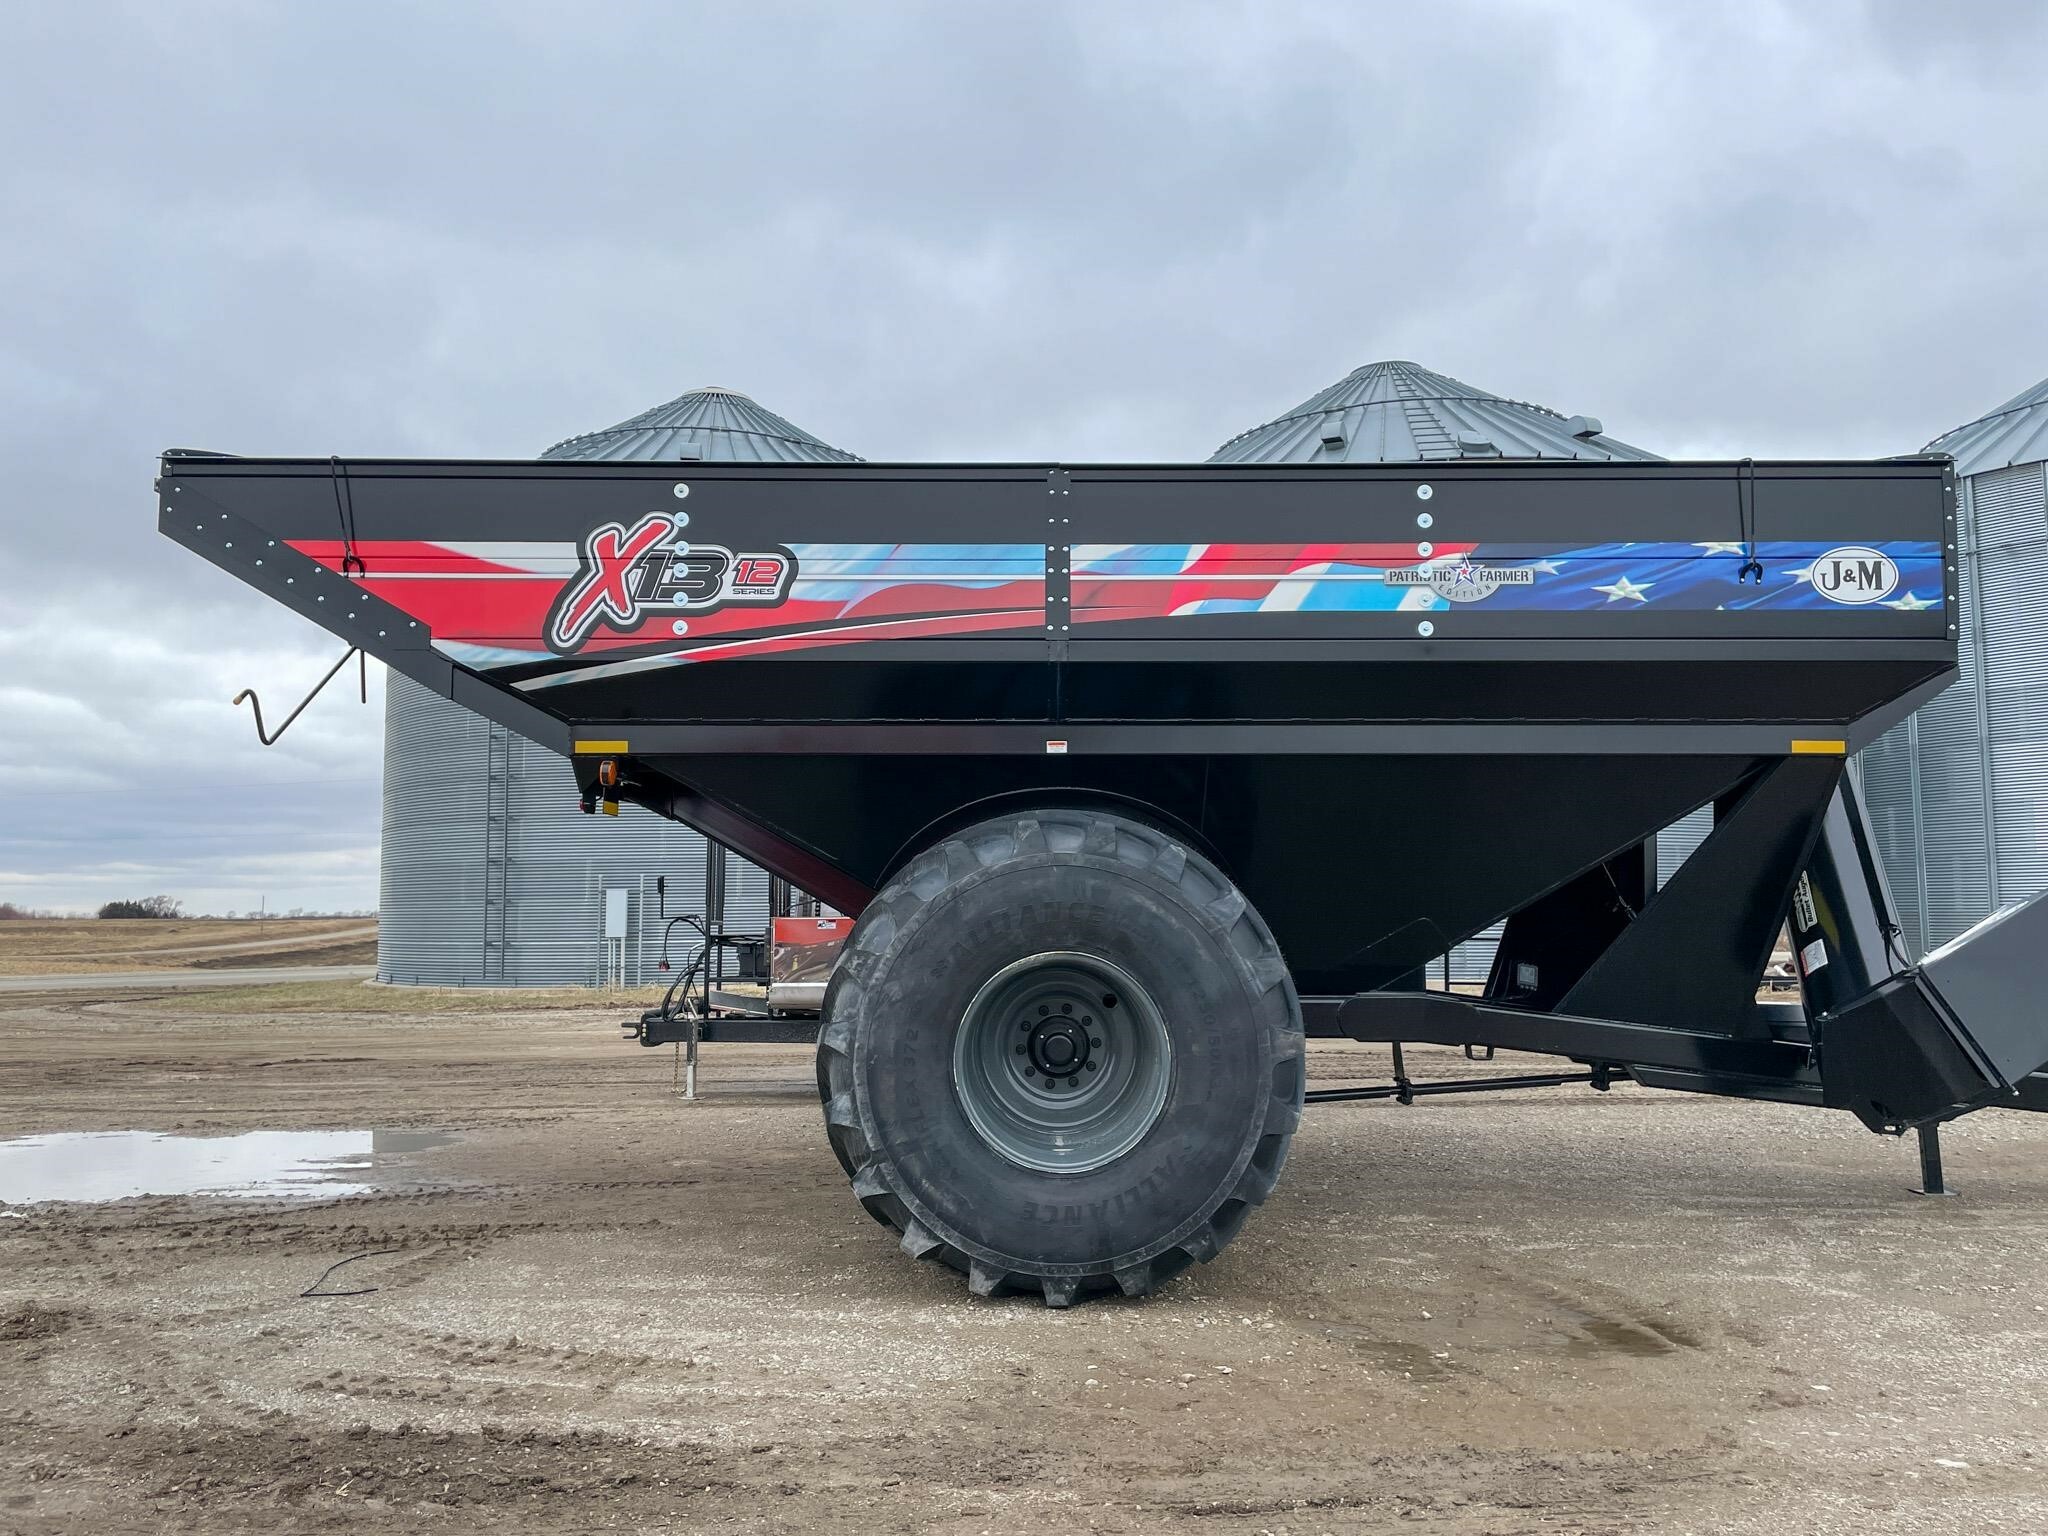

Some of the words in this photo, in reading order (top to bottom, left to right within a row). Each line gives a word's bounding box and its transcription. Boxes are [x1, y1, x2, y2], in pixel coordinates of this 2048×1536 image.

[557, 519, 727, 640] X13
[735, 560, 781, 584] 12
[1389, 570, 1451, 582] PATRTIC
[1479, 570, 1529, 582] FARMER
[1820, 560, 1884, 591] J&M
[732, 587, 775, 595] SERIES
[1438, 583, 1492, 597] EDITION
[1019, 1155, 1185, 1226] ALLIANCE
